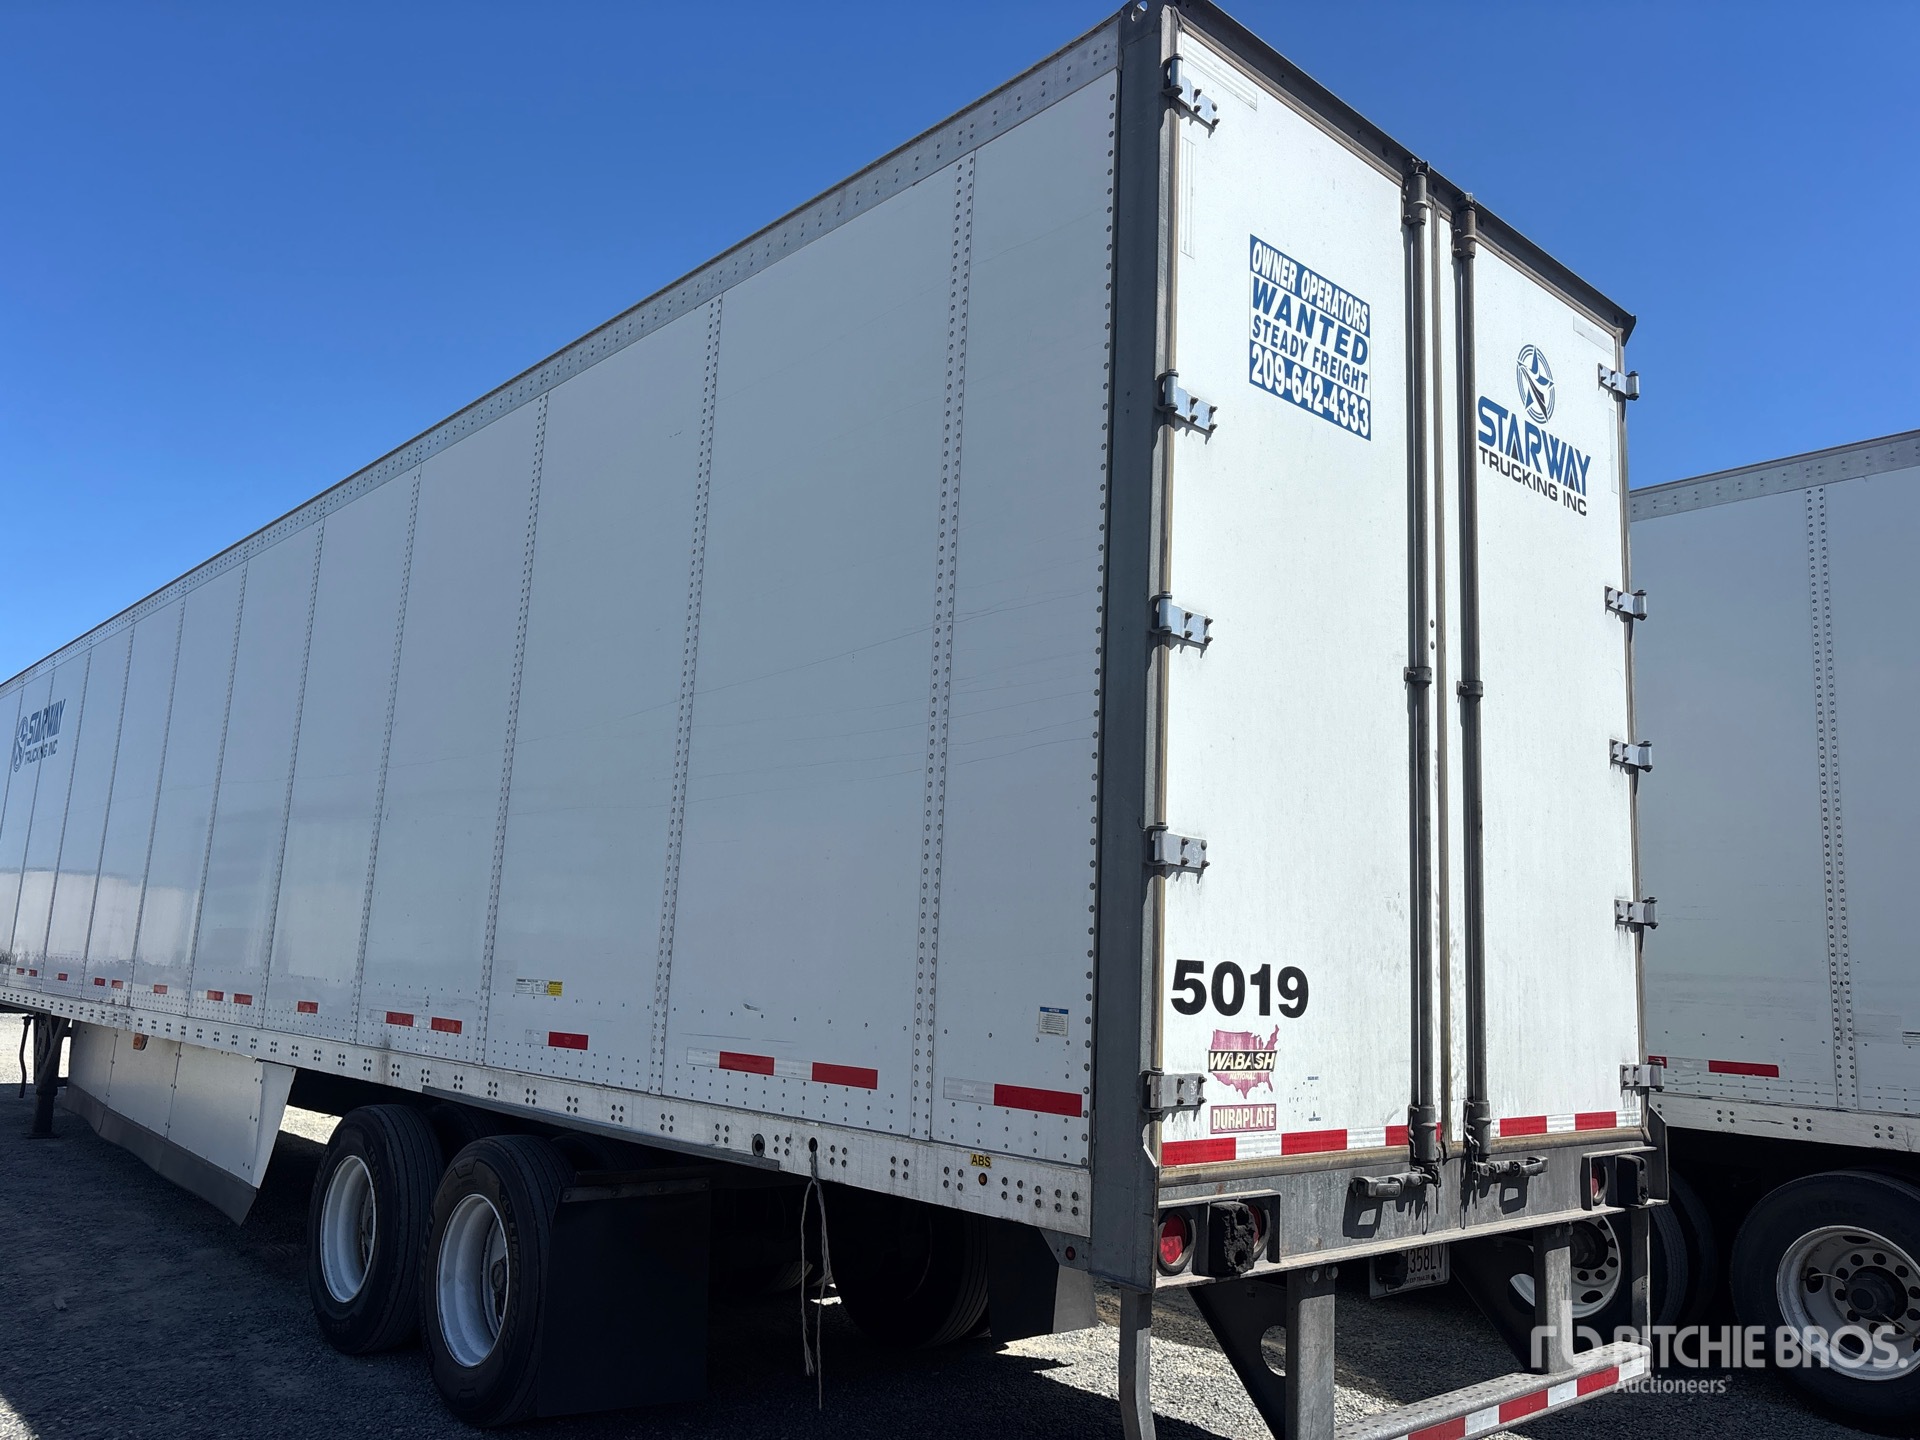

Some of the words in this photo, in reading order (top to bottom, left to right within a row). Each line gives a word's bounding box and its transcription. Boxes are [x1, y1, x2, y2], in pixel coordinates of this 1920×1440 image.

[1252, 241, 1298, 294] OWNER
[1301, 269, 1368, 334] OPERATORS
[1252, 275, 1368, 366] WANTED
[1251, 343, 1370, 437] 209-642-4333
[1252, 314, 1308, 362] STEADY
[1313, 346, 1368, 394] FREIGHT
[1478, 395, 1591, 497] STARWAY
[1478, 445, 1558, 502] TRUCKING
[1562, 490, 1587, 517] INC
[1170, 959, 1309, 1018] 5019
[1208, 1052, 1276, 1070] WABASH
[1212, 1107, 1275, 1131] DURAPLATE
[971, 1154, 991, 1168] ABS
